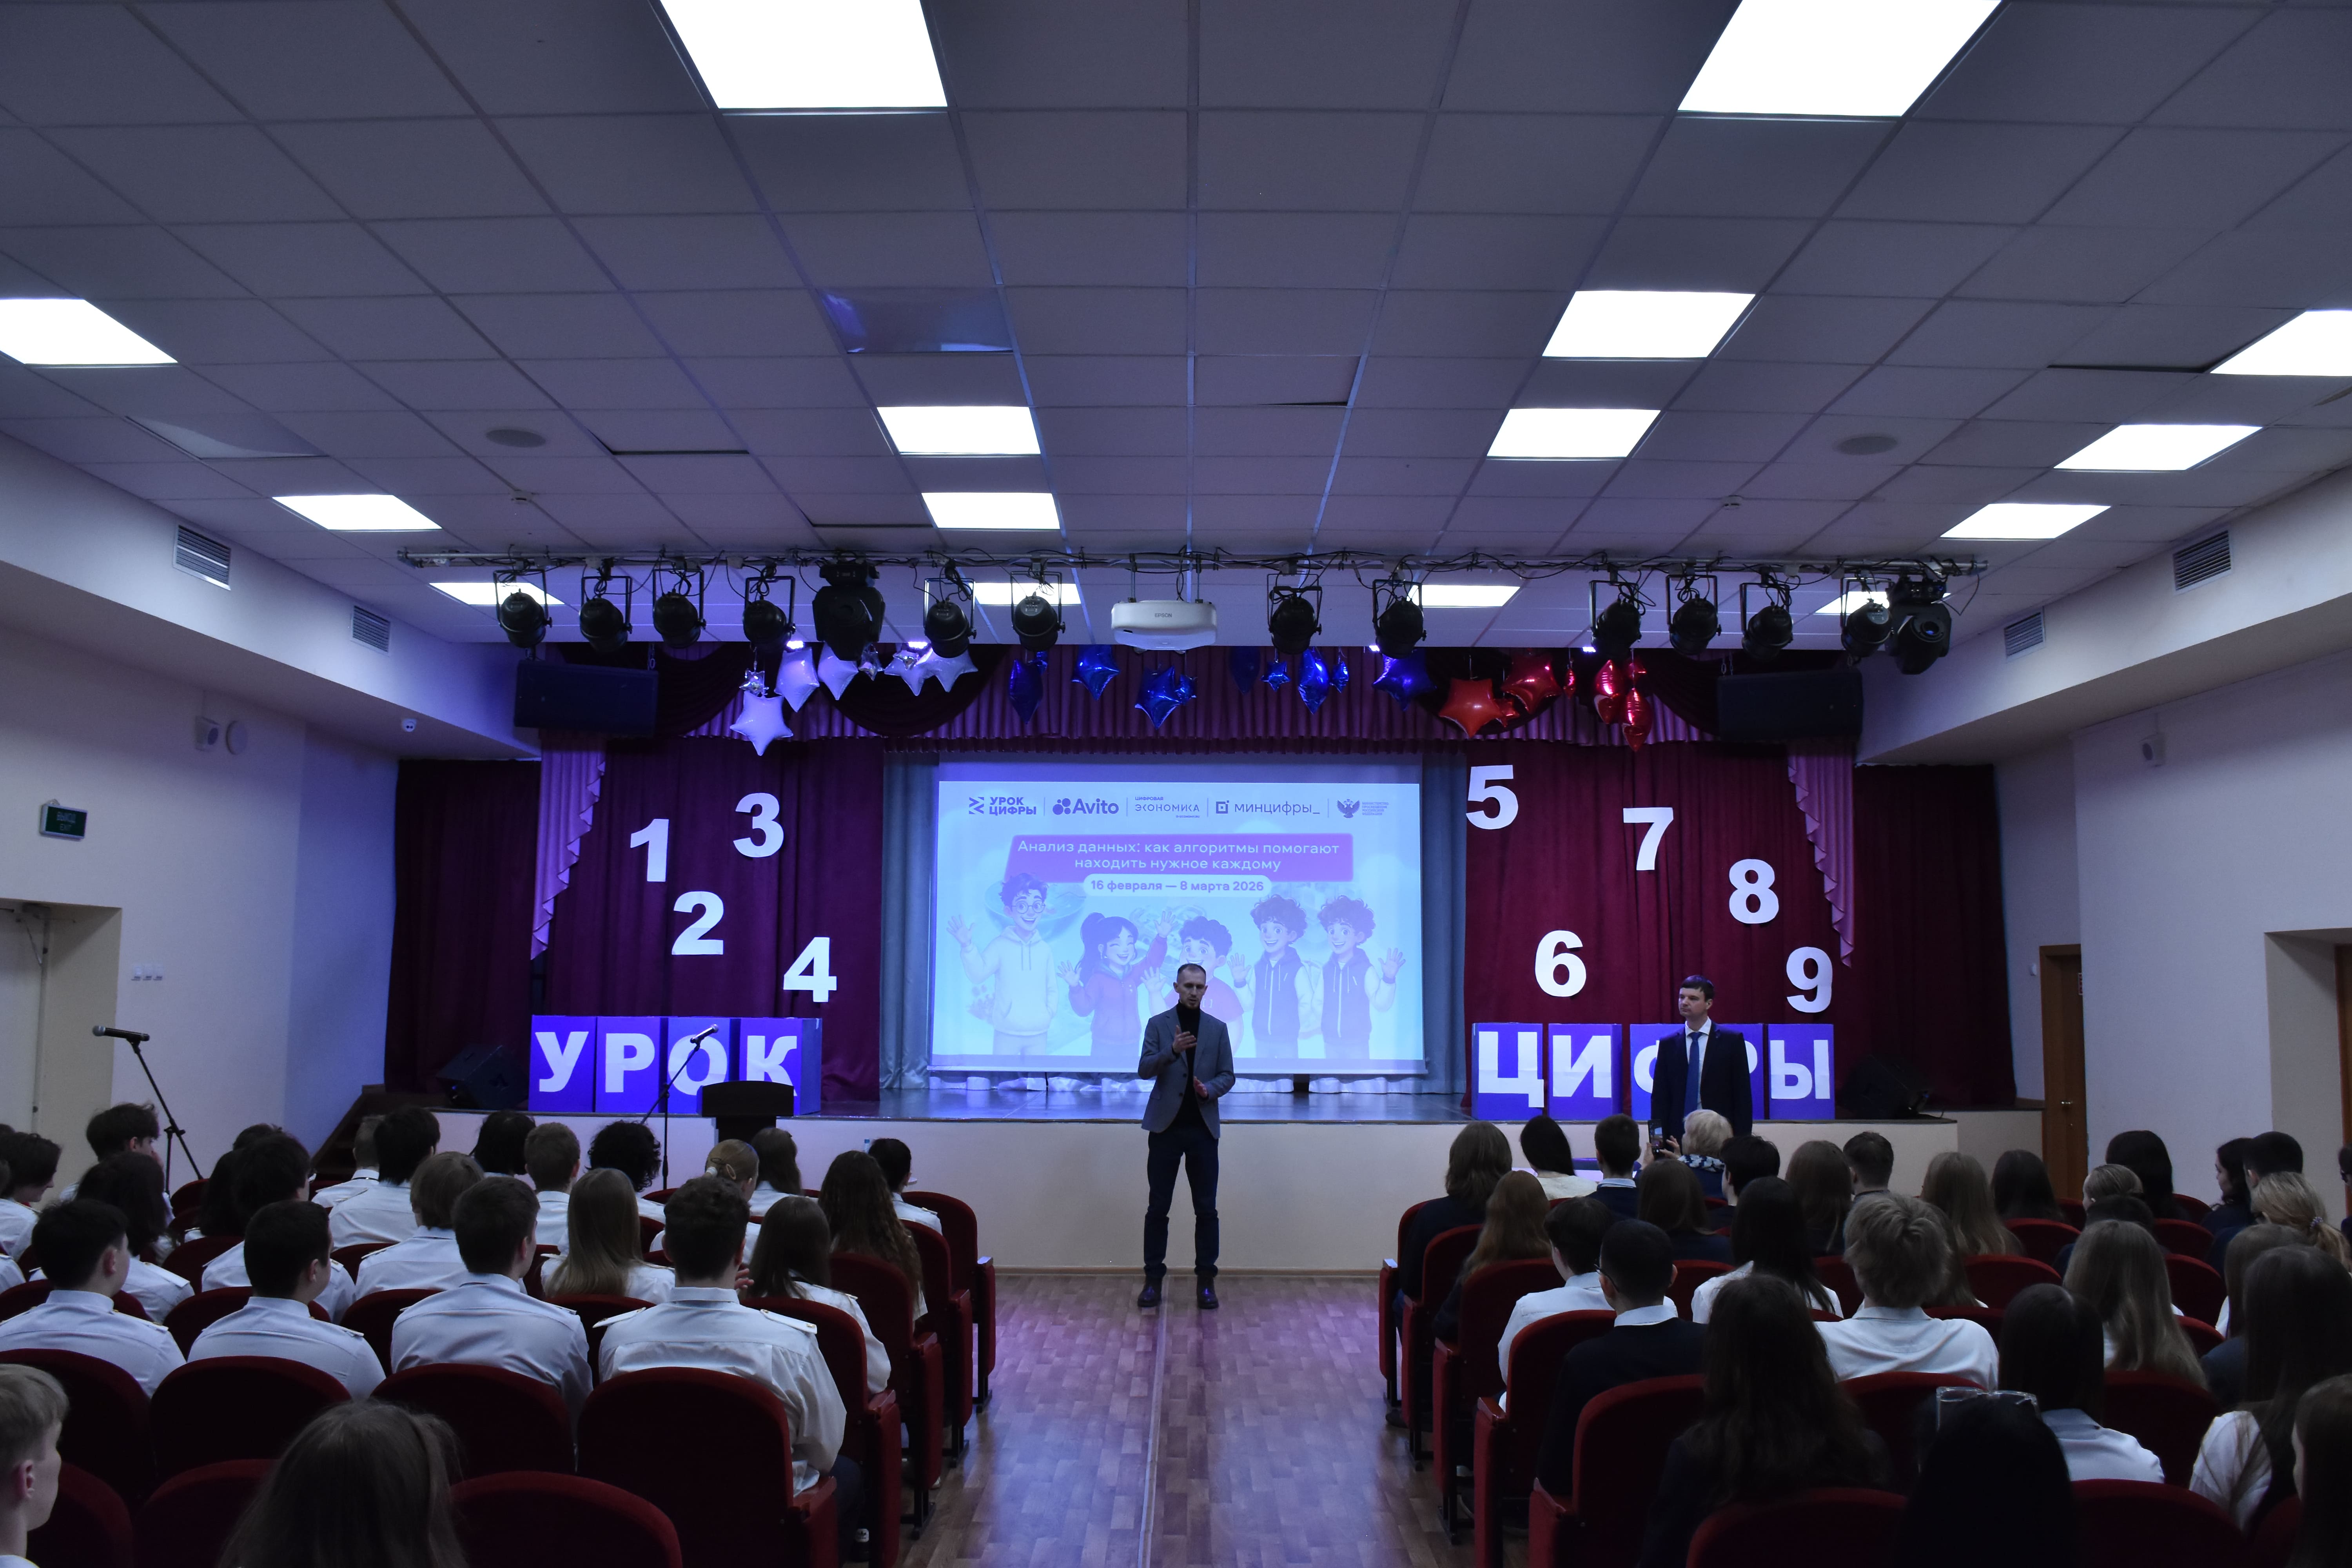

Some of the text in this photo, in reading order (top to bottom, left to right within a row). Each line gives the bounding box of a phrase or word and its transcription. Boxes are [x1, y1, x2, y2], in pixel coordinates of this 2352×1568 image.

[733, 793, 784, 858] 3
[989, 806, 1036, 816] ЦИФРЫ
[990, 797, 1024, 806] УРОК
[1072, 798, 1119, 814] Avito
[1466, 765, 1519, 830] 5
[630, 818, 669, 882] 1
[1018, 840, 1339, 856] Анализ данных: как алгоритмы помогают
[1075, 859, 1281, 872] находить нужное каждому
[1623, 807, 1674, 871] 7
[1091, 880, 1104, 890] 16
[1107, 880, 1162, 893] февраля
[1180, 880, 1187, 890] 8
[1191, 883, 1230, 893] марта
[1233, 881, 1264, 891] 2026
[1729, 859, 1779, 924] 8
[671, 891, 724, 955] 2
[783, 937, 837, 1002] 4
[1535, 930, 1586, 997] 6
[1786, 946, 1833, 1013] 9
[535, 1031, 797, 1096] УРОК
